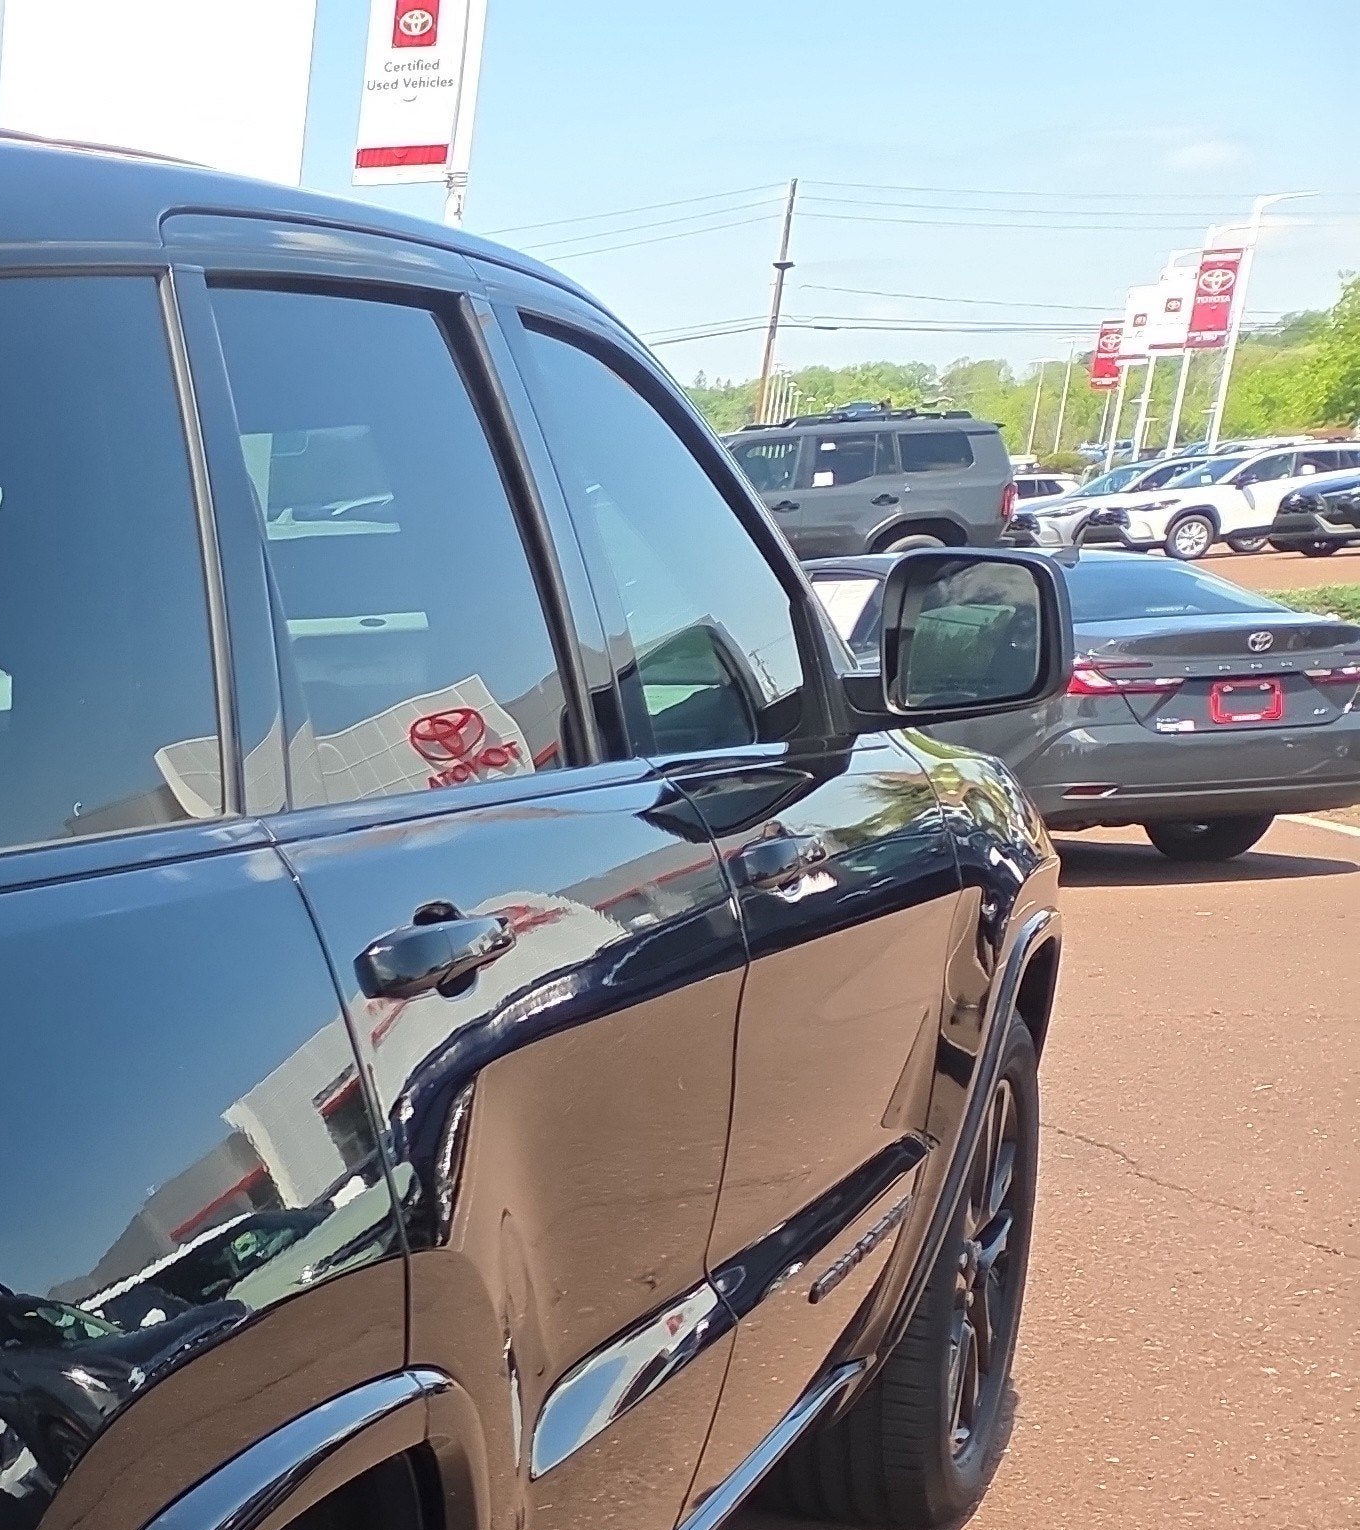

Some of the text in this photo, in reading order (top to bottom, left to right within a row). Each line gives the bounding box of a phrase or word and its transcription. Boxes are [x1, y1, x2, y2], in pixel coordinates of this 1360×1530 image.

[384, 59, 440, 73] Certified
[367, 76, 454, 91] Used Vehicles
[1196, 295, 1231, 304] TOYOTA
